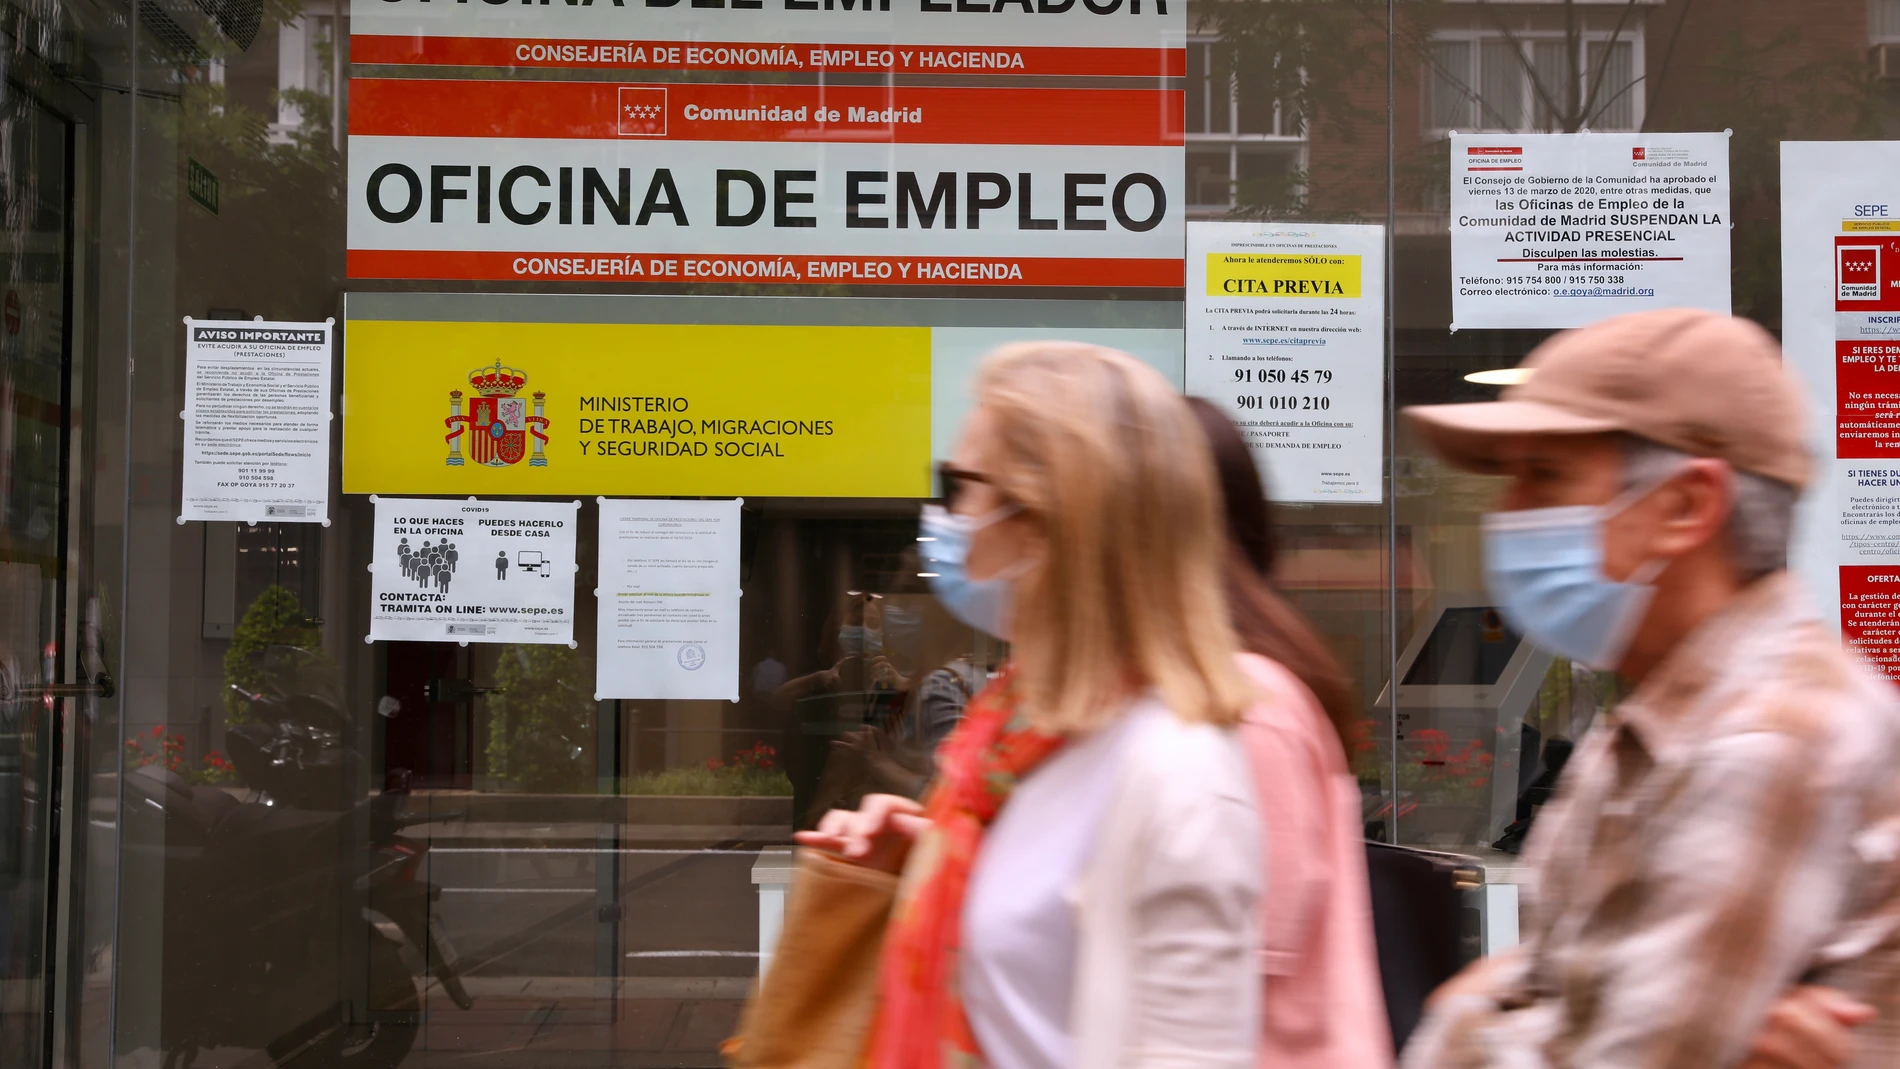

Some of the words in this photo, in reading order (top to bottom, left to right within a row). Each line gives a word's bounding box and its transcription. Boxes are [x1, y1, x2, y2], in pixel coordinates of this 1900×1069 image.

[513, 42, 647, 68] CONSEJERÍA
[653, 47, 680, 63] DE
[686, 44, 803, 68] ECONOMÍA,
[809, 47, 894, 71] EMPLEO
[899, 50, 913, 67] Y
[919, 51, 1024, 68] HACIENDA
[683, 103, 807, 122] Comunidad
[813, 100, 840, 129] de
[847, 100, 922, 130] Madrid
[1462, 176, 1472, 185] El
[1474, 176, 1512, 186] Consejo
[1513, 176, 1525, 184] de
[1527, 175, 1570, 184] Gobierno
[1571, 175, 1582, 184] de
[1585, 175, 1593, 184] la
[1595, 175, 1646, 184] Comunidad
[1649, 175, 1660, 183] ha
[1662, 174, 1706, 185] aprobado
[1708, 174, 1716, 183] el
[1468, 187, 1501, 195] viernes
[1504, 186, 1514, 195] 13
[1516, 186, 1528, 195] de
[1560, 186, 1572, 195] de
[1573, 186, 1598, 195] 2020,
[1625, 186, 1648, 194] otras
[1650, 185, 1692, 195] medidas,
[1694, 187, 1711, 195] que
[366, 162, 689, 227] OFICINA
[715, 168, 816, 227] DE
[845, 169, 1166, 232] EMPLEO
[1495, 199, 1514, 210] las
[1518, 198, 1573, 210] Oficinas
[1577, 198, 1594, 210] de
[1598, 198, 1648, 212] Empleo
[1652, 197, 1669, 209] de
[1673, 197, 1684, 209] la
[1854, 204, 1888, 216] SEPE
[1458, 214, 1536, 226] Comunidad
[1540, 214, 1556, 226] de
[1560, 214, 1606, 226] Madrid
[1610, 213, 1698, 226] SUSPENDAN
[1702, 213, 1721, 224] LA
[1504, 230, 1580, 242] ACTIVIDAD
[1585, 229, 1675, 242] PRESENCIAL
[1522, 248, 1578, 258] Disculpen
[1581, 247, 1597, 257] las
[1600, 247, 1659, 258] molestias.
[1303, 255, 1327, 264] SÓLO
[512, 253, 644, 276] CONSEJERÍA
[650, 259, 677, 276] DE
[683, 255, 800, 280] ECONOMÍA,
[807, 260, 892, 278] EMPLEO
[897, 262, 911, 278] Y
[916, 262, 1025, 286] HACIENDA
[1537, 262, 1558, 271] Para
[1561, 262, 1581, 271] más
[1583, 262, 1643, 271] información:
[1459, 276, 1503, 284] Teléfono:
[1506, 276, 1523, 284] 915
[1525, 276, 1542, 284] 754
[1544, 275, 1561, 284] 800
[1563, 275, 1567, 284] /
[1568, 275, 1586, 284] 915
[1588, 275, 1605, 284] 750
[1607, 275, 1624, 284] 338
[1223, 278, 1268, 293] CITA
[1273, 279, 1343, 294] PREVIA
[1459, 287, 1492, 296] Correo
[1494, 287, 1550, 295] electrónico:
[1552, 286, 1654, 297] o.e.goya@madrid.org
[197, 330, 237, 340] AVISO
[239, 330, 321, 341] IMPORTANTE
[1242, 336, 1326, 346] www.sepe.es/citaprevia
[1852, 346, 1860, 354] SI
[1862, 346, 1883, 354] ERES
[1842, 355, 1876, 363] EMPLEO
[1878, 355, 1885, 363] Y
[1886, 355, 1896, 363] TE
[1873, 364, 1884, 372] LA
[1234, 368, 1251, 382] 91
[1258, 368, 1285, 383] 050
[1290, 369, 1308, 383] 45
[1314, 369, 1332, 383] 79
[580, 396, 688, 412] MINISTERIO
[1236, 395, 1262, 409] 901
[1269, 395, 1297, 409] 010
[1302, 396, 1329, 410] 210
[1844, 400, 1876, 411] ningún
[579, 418, 604, 433] DE
[607, 418, 696, 438] TRABAJO,
[701, 419, 833, 435] MIGRACIONES
[1839, 430, 1889, 438] enviaremos
[578, 440, 591, 455] Y
[597, 440, 707, 456] SEGURIDAD
[714, 441, 784, 457] SOCIAL
[1874, 440, 1883, 448] la
[1847, 469, 1856, 477] SI
[1857, 469, 1888, 477] TIENES
[1857, 478, 1887, 486] HACER
[408, 517, 429, 525] QUE
[431, 517, 464, 526] HACES
[478, 518, 516, 527] PUEDES
[518, 519, 563, 528] HACERLO
[424, 527, 463, 535] OFICINA
[490, 528, 522, 536] DESDE
[524, 529, 550, 537] CASA
[379, 592, 445, 602] CONTACTA:
[379, 603, 432, 613] TRAMITA
[435, 604, 452, 613] ON
[455, 605, 486, 614] LINE:
[488, 606, 563, 616] www.sepe.es
